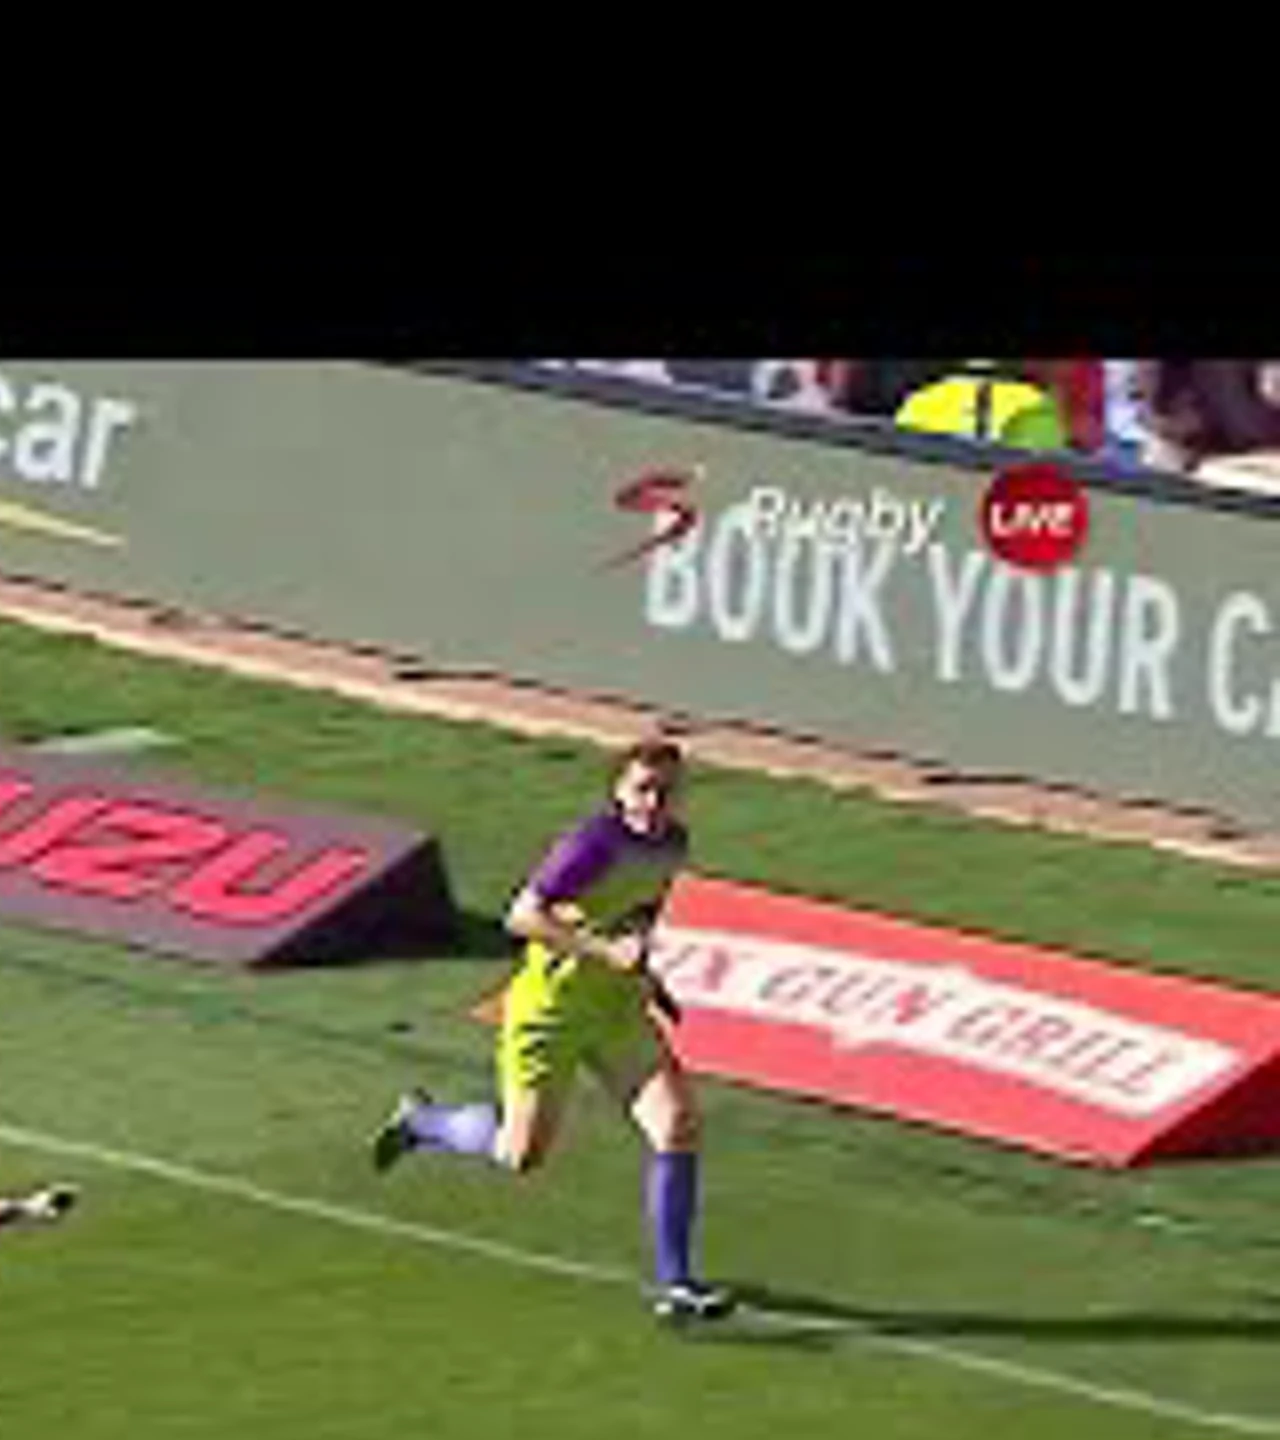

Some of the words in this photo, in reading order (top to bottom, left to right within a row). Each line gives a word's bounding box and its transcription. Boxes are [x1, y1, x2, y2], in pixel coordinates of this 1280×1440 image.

[643, 502, 896, 674] BOOK
[928, 545, 1178, 720] YOUR
[758, 964, 952, 1027] GUN
[950, 1003, 1185, 1098] GRILL
